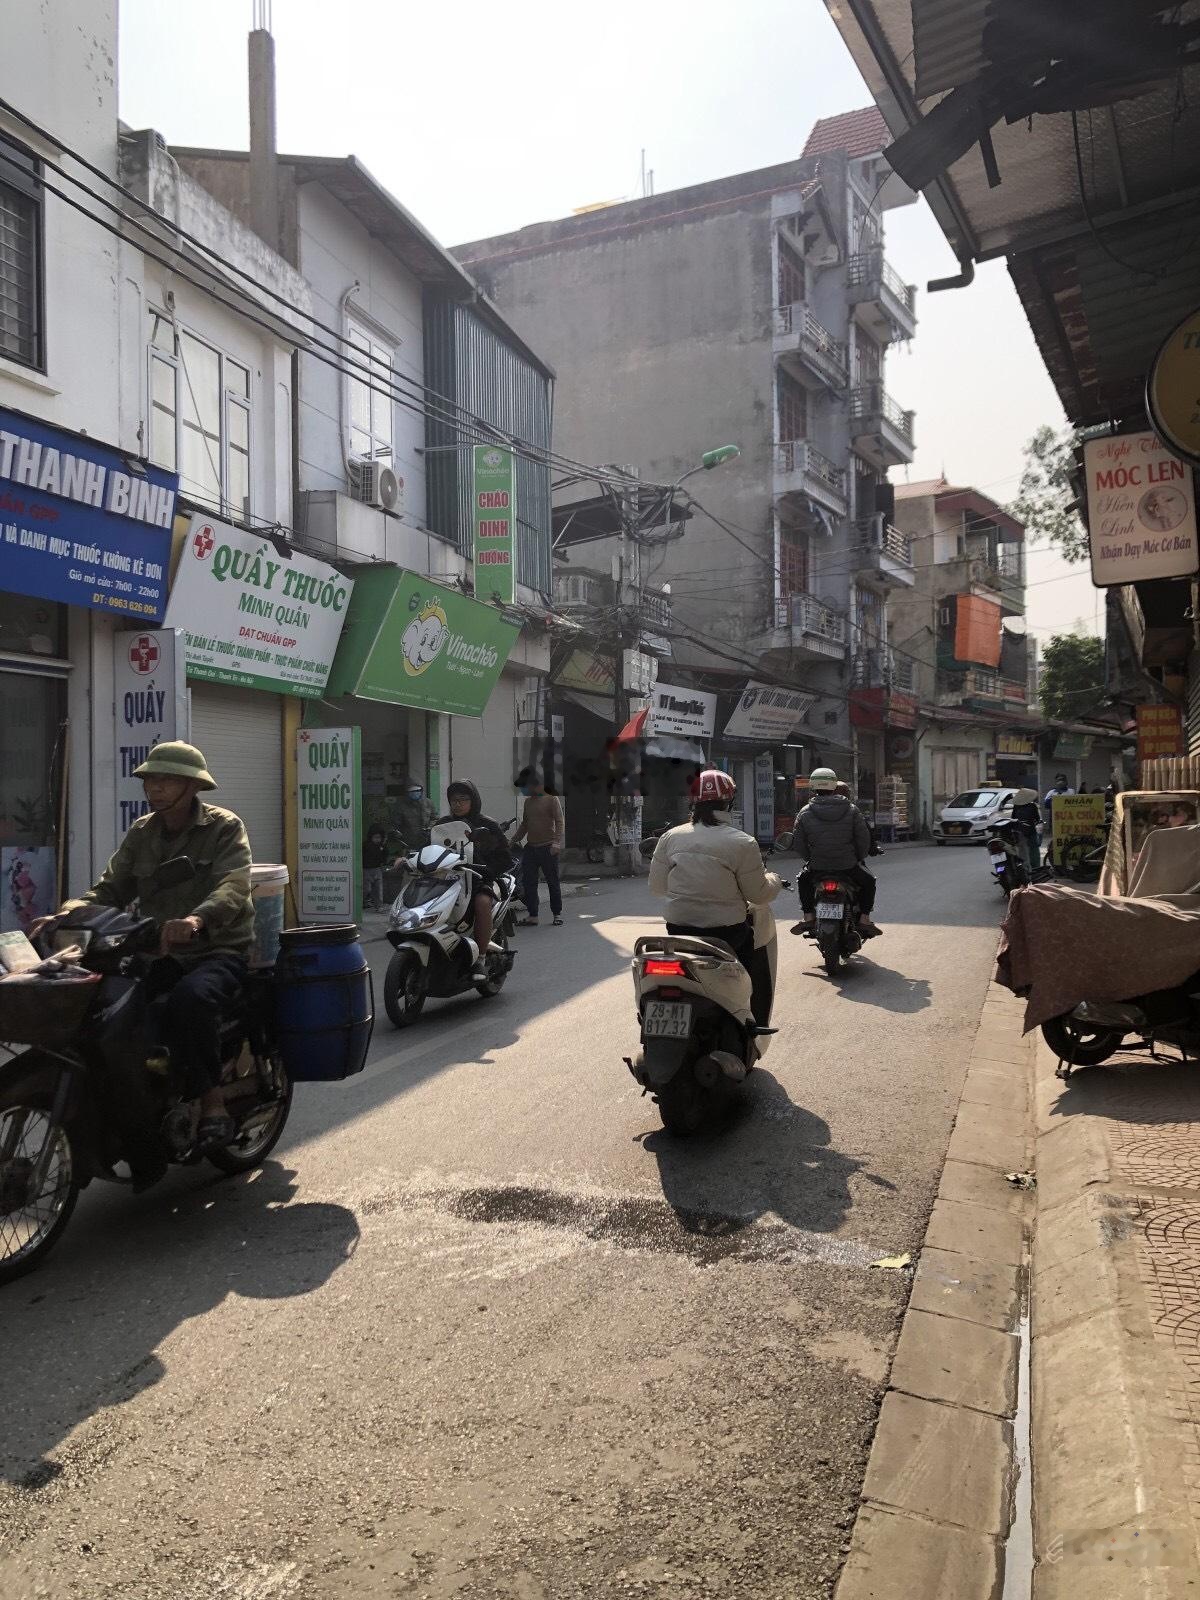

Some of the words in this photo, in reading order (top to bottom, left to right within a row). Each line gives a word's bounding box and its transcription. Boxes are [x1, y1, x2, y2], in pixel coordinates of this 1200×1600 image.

[0, 431, 106, 508] THANH
[1095, 462, 1141, 492] MÓC
[1147, 459, 1186, 484] LEN
[478, 489, 510, 508] CHÁO
[479, 519, 509, 537] DINH
[1100, 519, 1135, 538] Linh
[5, 522, 17, 544] VÀ
[20, 529, 47, 551] DANH
[49, 536, 71, 559] MỤC
[73, 542, 101, 565] THUỐC
[103, 551, 131, 573] KHÔNG
[132, 557, 144, 576] KÊ
[1100, 544, 1123, 562] Nhận
[1124, 542, 1142, 559] Dạy
[1143, 538, 1160, 554] Móc
[115, 580, 133, 592] 7h00
[138, 586, 160, 599] 22h00
[211, 544, 281, 590] QUẦY
[283, 569, 346, 612] THUỐC
[238, 592, 275, 620] MINH
[275, 606, 311, 630] QUÂN
[282, 637, 297, 648] GPP
[447, 633, 498, 668] Vinacháo
[124, 680, 166, 727] QUẦY
[309, 733, 350, 771] QUẦY
[300, 774, 350, 809] THUỐC
[303, 818, 325, 828] MINH
[326, 816, 349, 831] QUÂN
